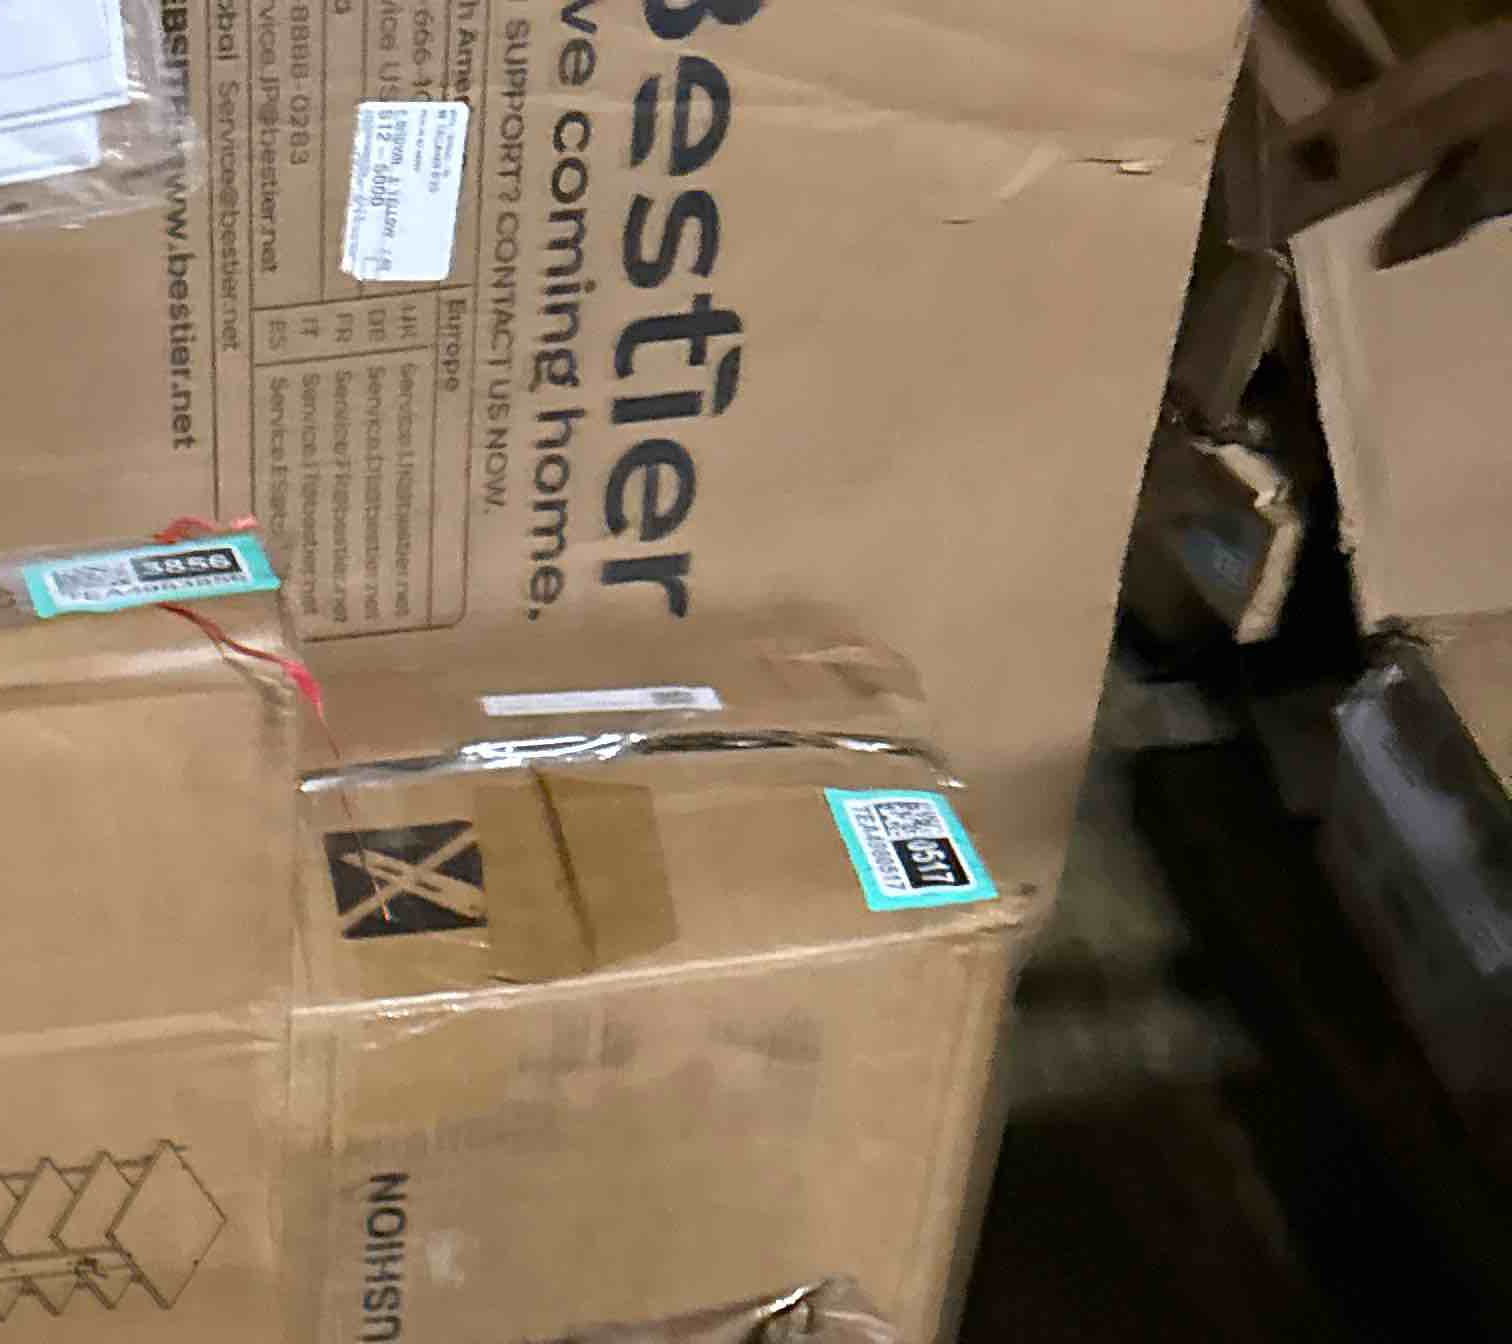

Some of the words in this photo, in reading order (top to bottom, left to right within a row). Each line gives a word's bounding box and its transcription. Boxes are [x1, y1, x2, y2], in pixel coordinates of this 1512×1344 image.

[498, 20, 530, 201] SUPPORT?
[486, 212, 518, 369] CONTACT
[531, 111, 596, 387] coming
[443, 299, 466, 392] Europe
[486, 378, 510, 420] US
[483, 428, 508, 515] NOW.
[527, 410, 585, 622] home.
[907, 840, 954, 882] 0517
